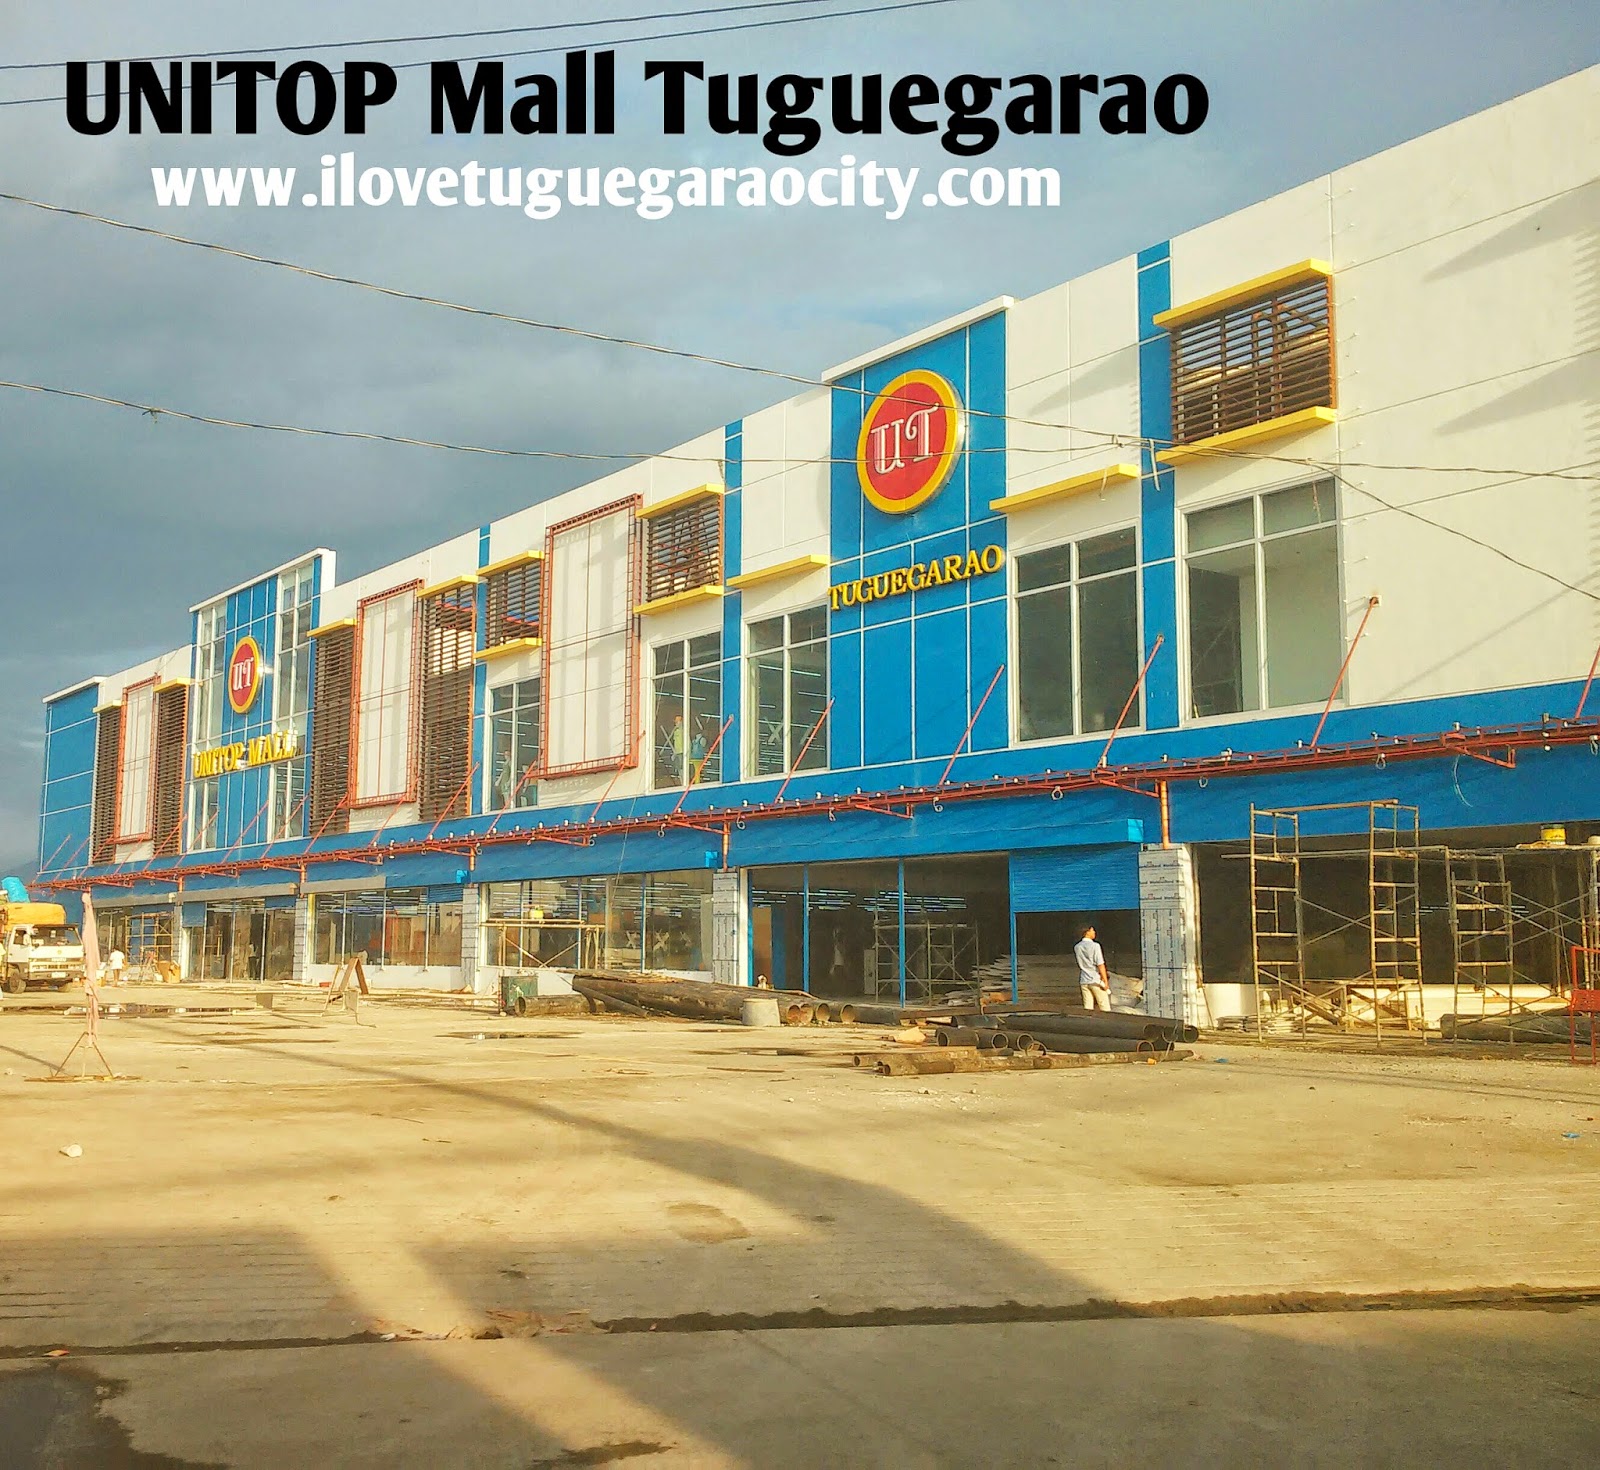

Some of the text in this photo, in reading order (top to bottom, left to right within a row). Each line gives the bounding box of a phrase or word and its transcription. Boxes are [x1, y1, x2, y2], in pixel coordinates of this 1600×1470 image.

[872, 403, 939, 474] UT
[829, 545, 1005, 610] TUGUEGARAO
[233, 658, 254, 690] UT
[194, 730, 297, 777] UNITOP MALL
